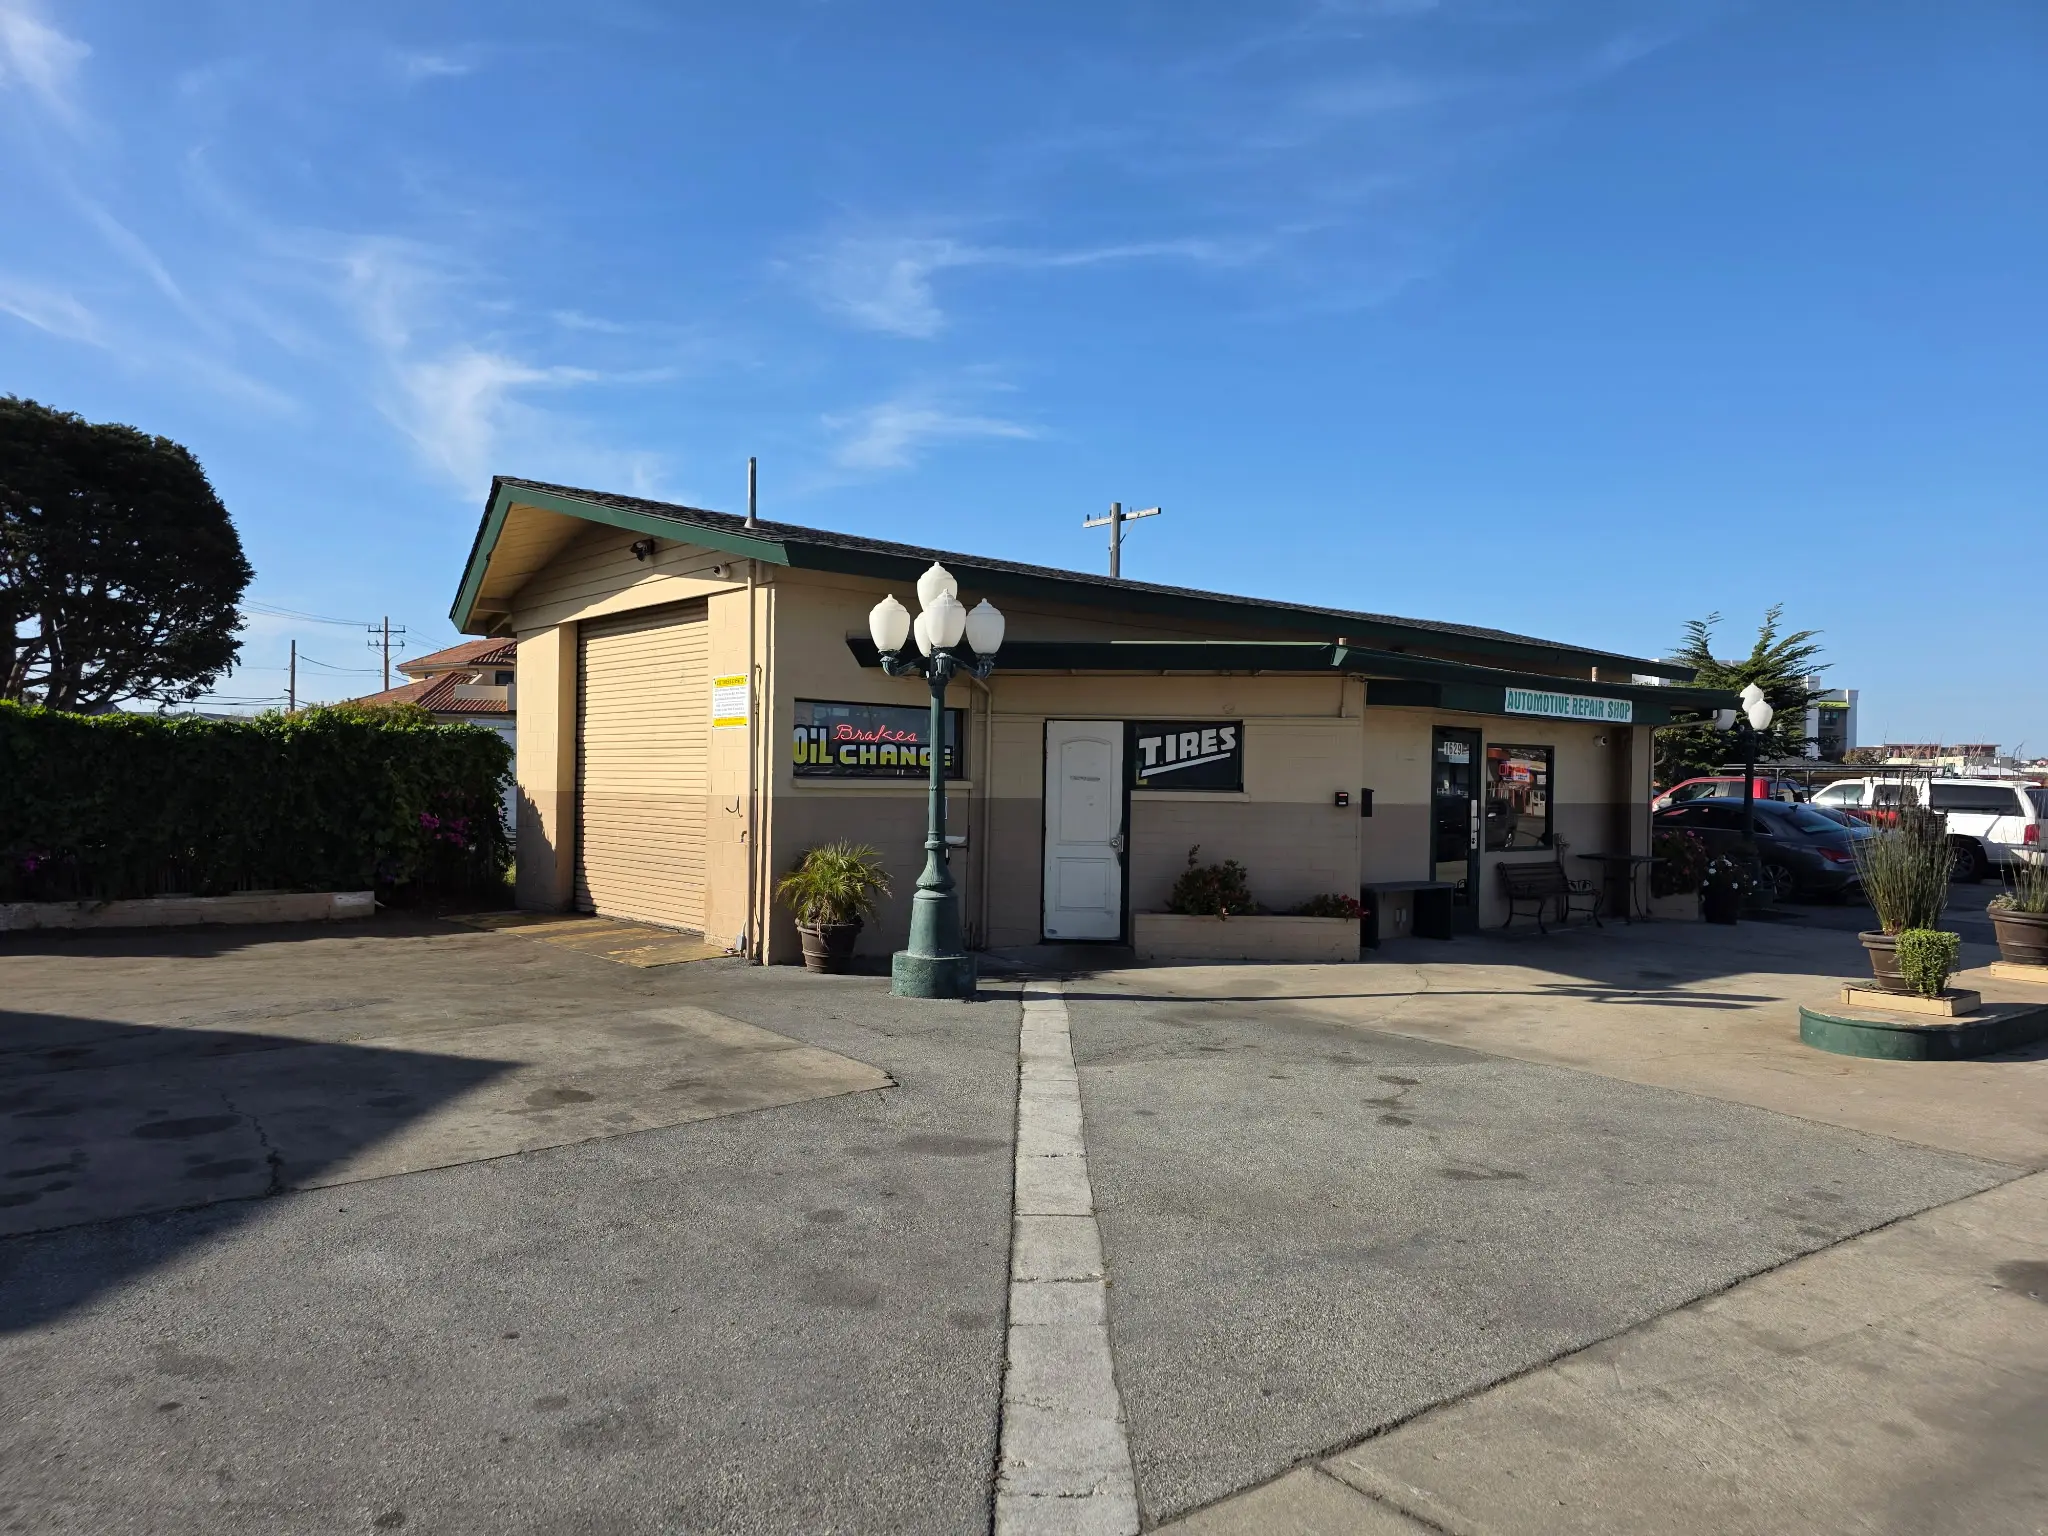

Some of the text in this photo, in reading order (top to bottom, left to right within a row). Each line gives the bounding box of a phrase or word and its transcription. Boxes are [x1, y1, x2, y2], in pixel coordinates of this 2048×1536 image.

[1507, 690, 1631, 720] AUTOMOTIVE REPAIR SHOP
[833, 724, 918, 743] Brakes
[1138, 726, 1236, 767] TIRES
[1444, 742, 1463, 755] 1629
